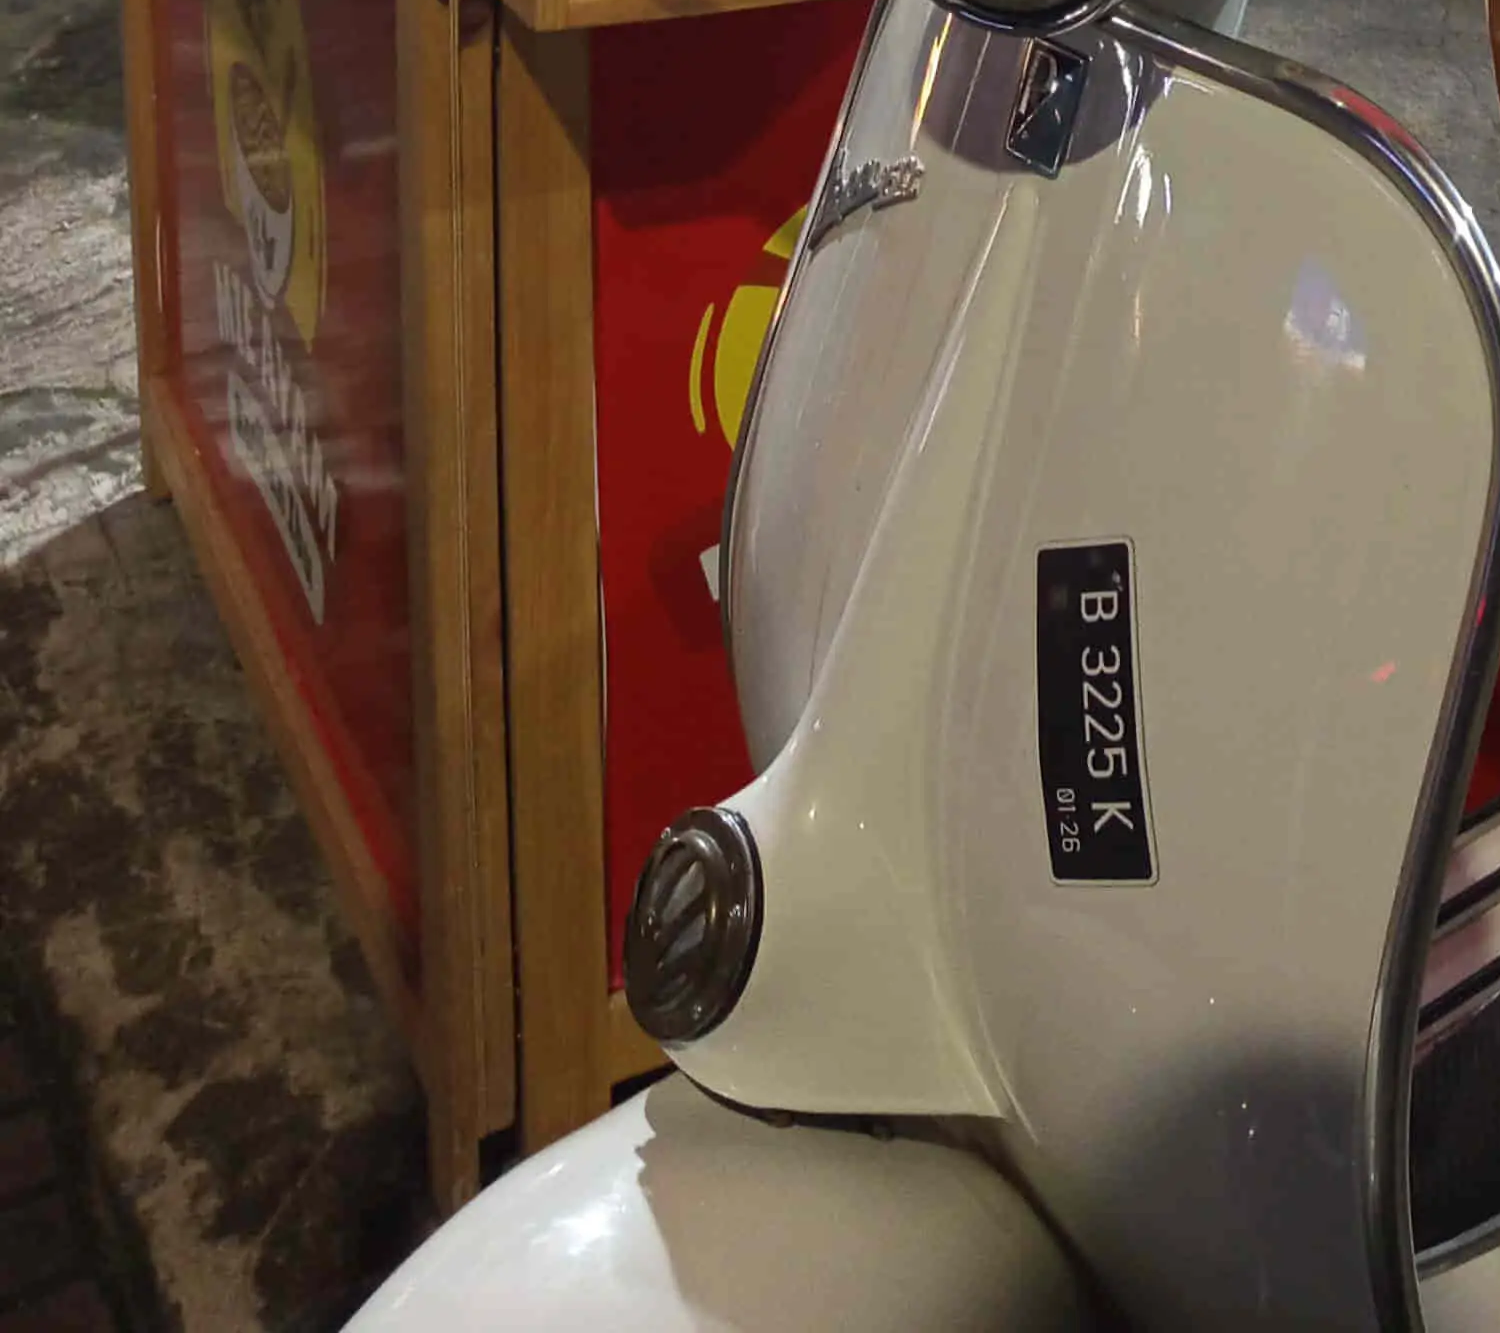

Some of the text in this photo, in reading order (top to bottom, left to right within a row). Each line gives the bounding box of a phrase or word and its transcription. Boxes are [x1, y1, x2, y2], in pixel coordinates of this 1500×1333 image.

[213, 262, 257, 366] MIE
[260, 309, 338, 565] AYAM
[1080, 590, 1134, 832] B 3225 K
